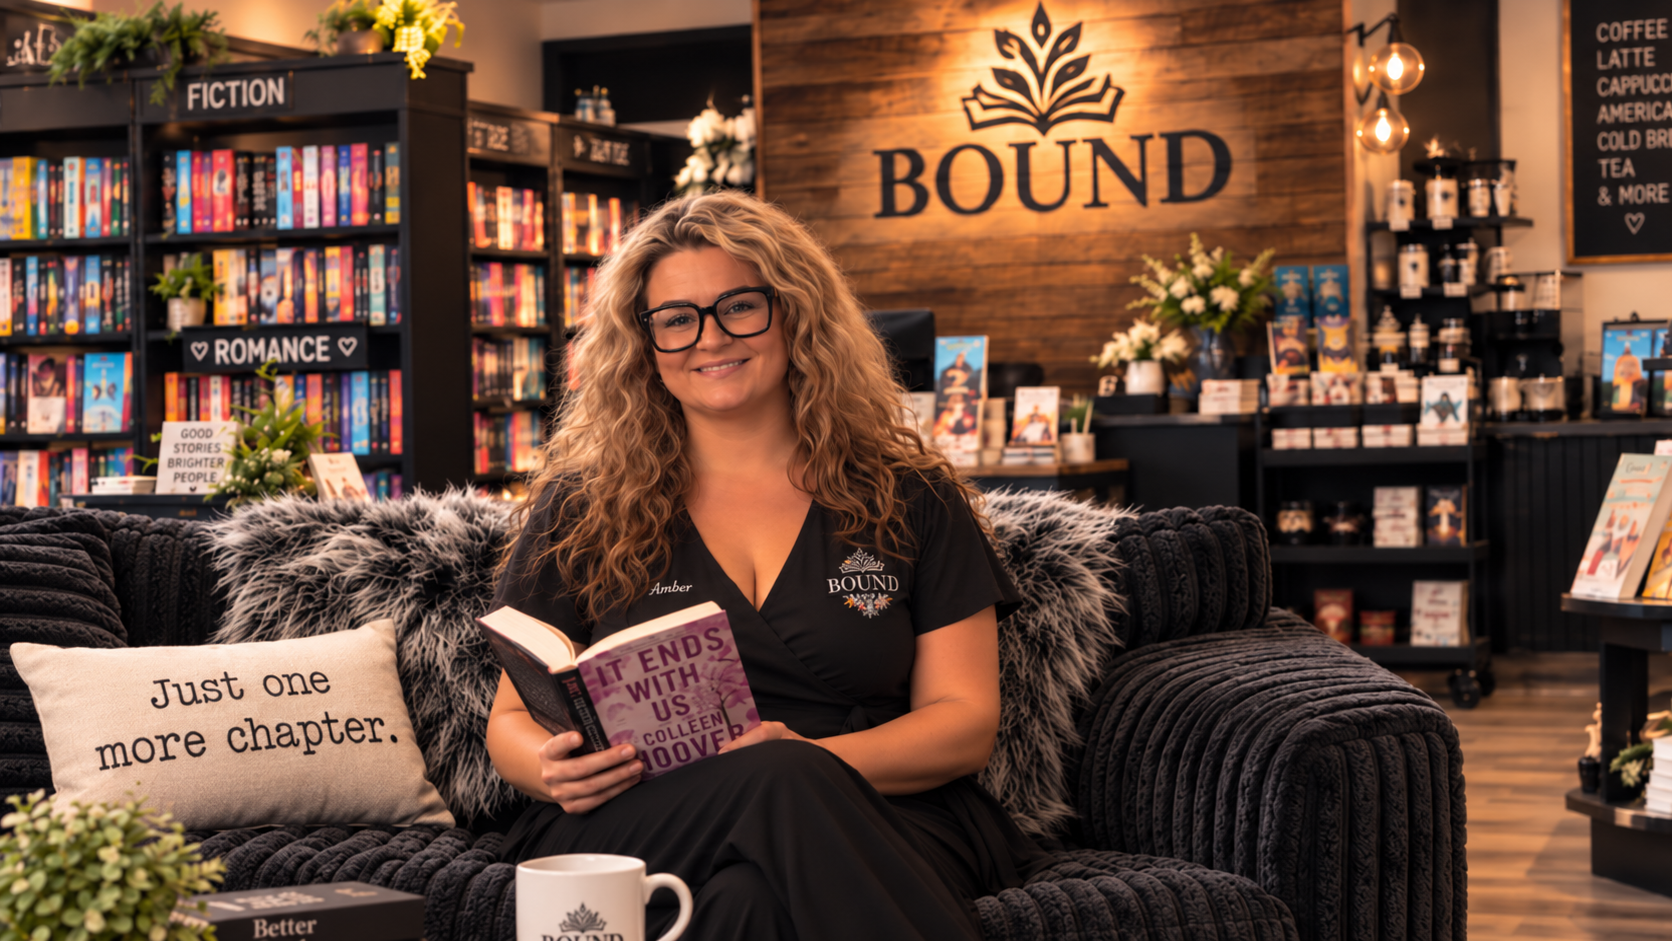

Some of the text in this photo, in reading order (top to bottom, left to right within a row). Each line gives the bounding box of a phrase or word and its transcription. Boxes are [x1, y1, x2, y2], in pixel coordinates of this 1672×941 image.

[1596, 18, 1669, 43] COFFEE
[1597, 46, 1656, 70] LATTE
[187, 77, 285, 111] FICTION
[1596, 73, 1672, 97] CAPPUCC
[1596, 101, 1672, 124] AMERICA
[1597, 130, 1641, 151] COLD
[872, 129, 1233, 218] BOUND
[1597, 157, 1636, 179] TEA
[1597, 183, 1670, 206] & MORE
[214, 335, 331, 366] ROMANCE
[180, 428, 214, 440] GOOD
[173, 442, 222, 454] STORIES
[167, 457, 225, 469] BRIGHTER
[173, 471, 217, 483] PEOPLE
[648, 580, 693, 596] Amber
[826, 574, 899, 594] BOUND
[595, 658, 623, 688] IT
[637, 627, 724, 674] ENDS
[150, 671, 331, 709] Just one
[625, 662, 700, 704] WITH
[651, 694, 691, 722] US
[642, 711, 724, 746] COLLEEN
[95, 711, 399, 771] more chapter.
[253, 918, 317, 939] Better
